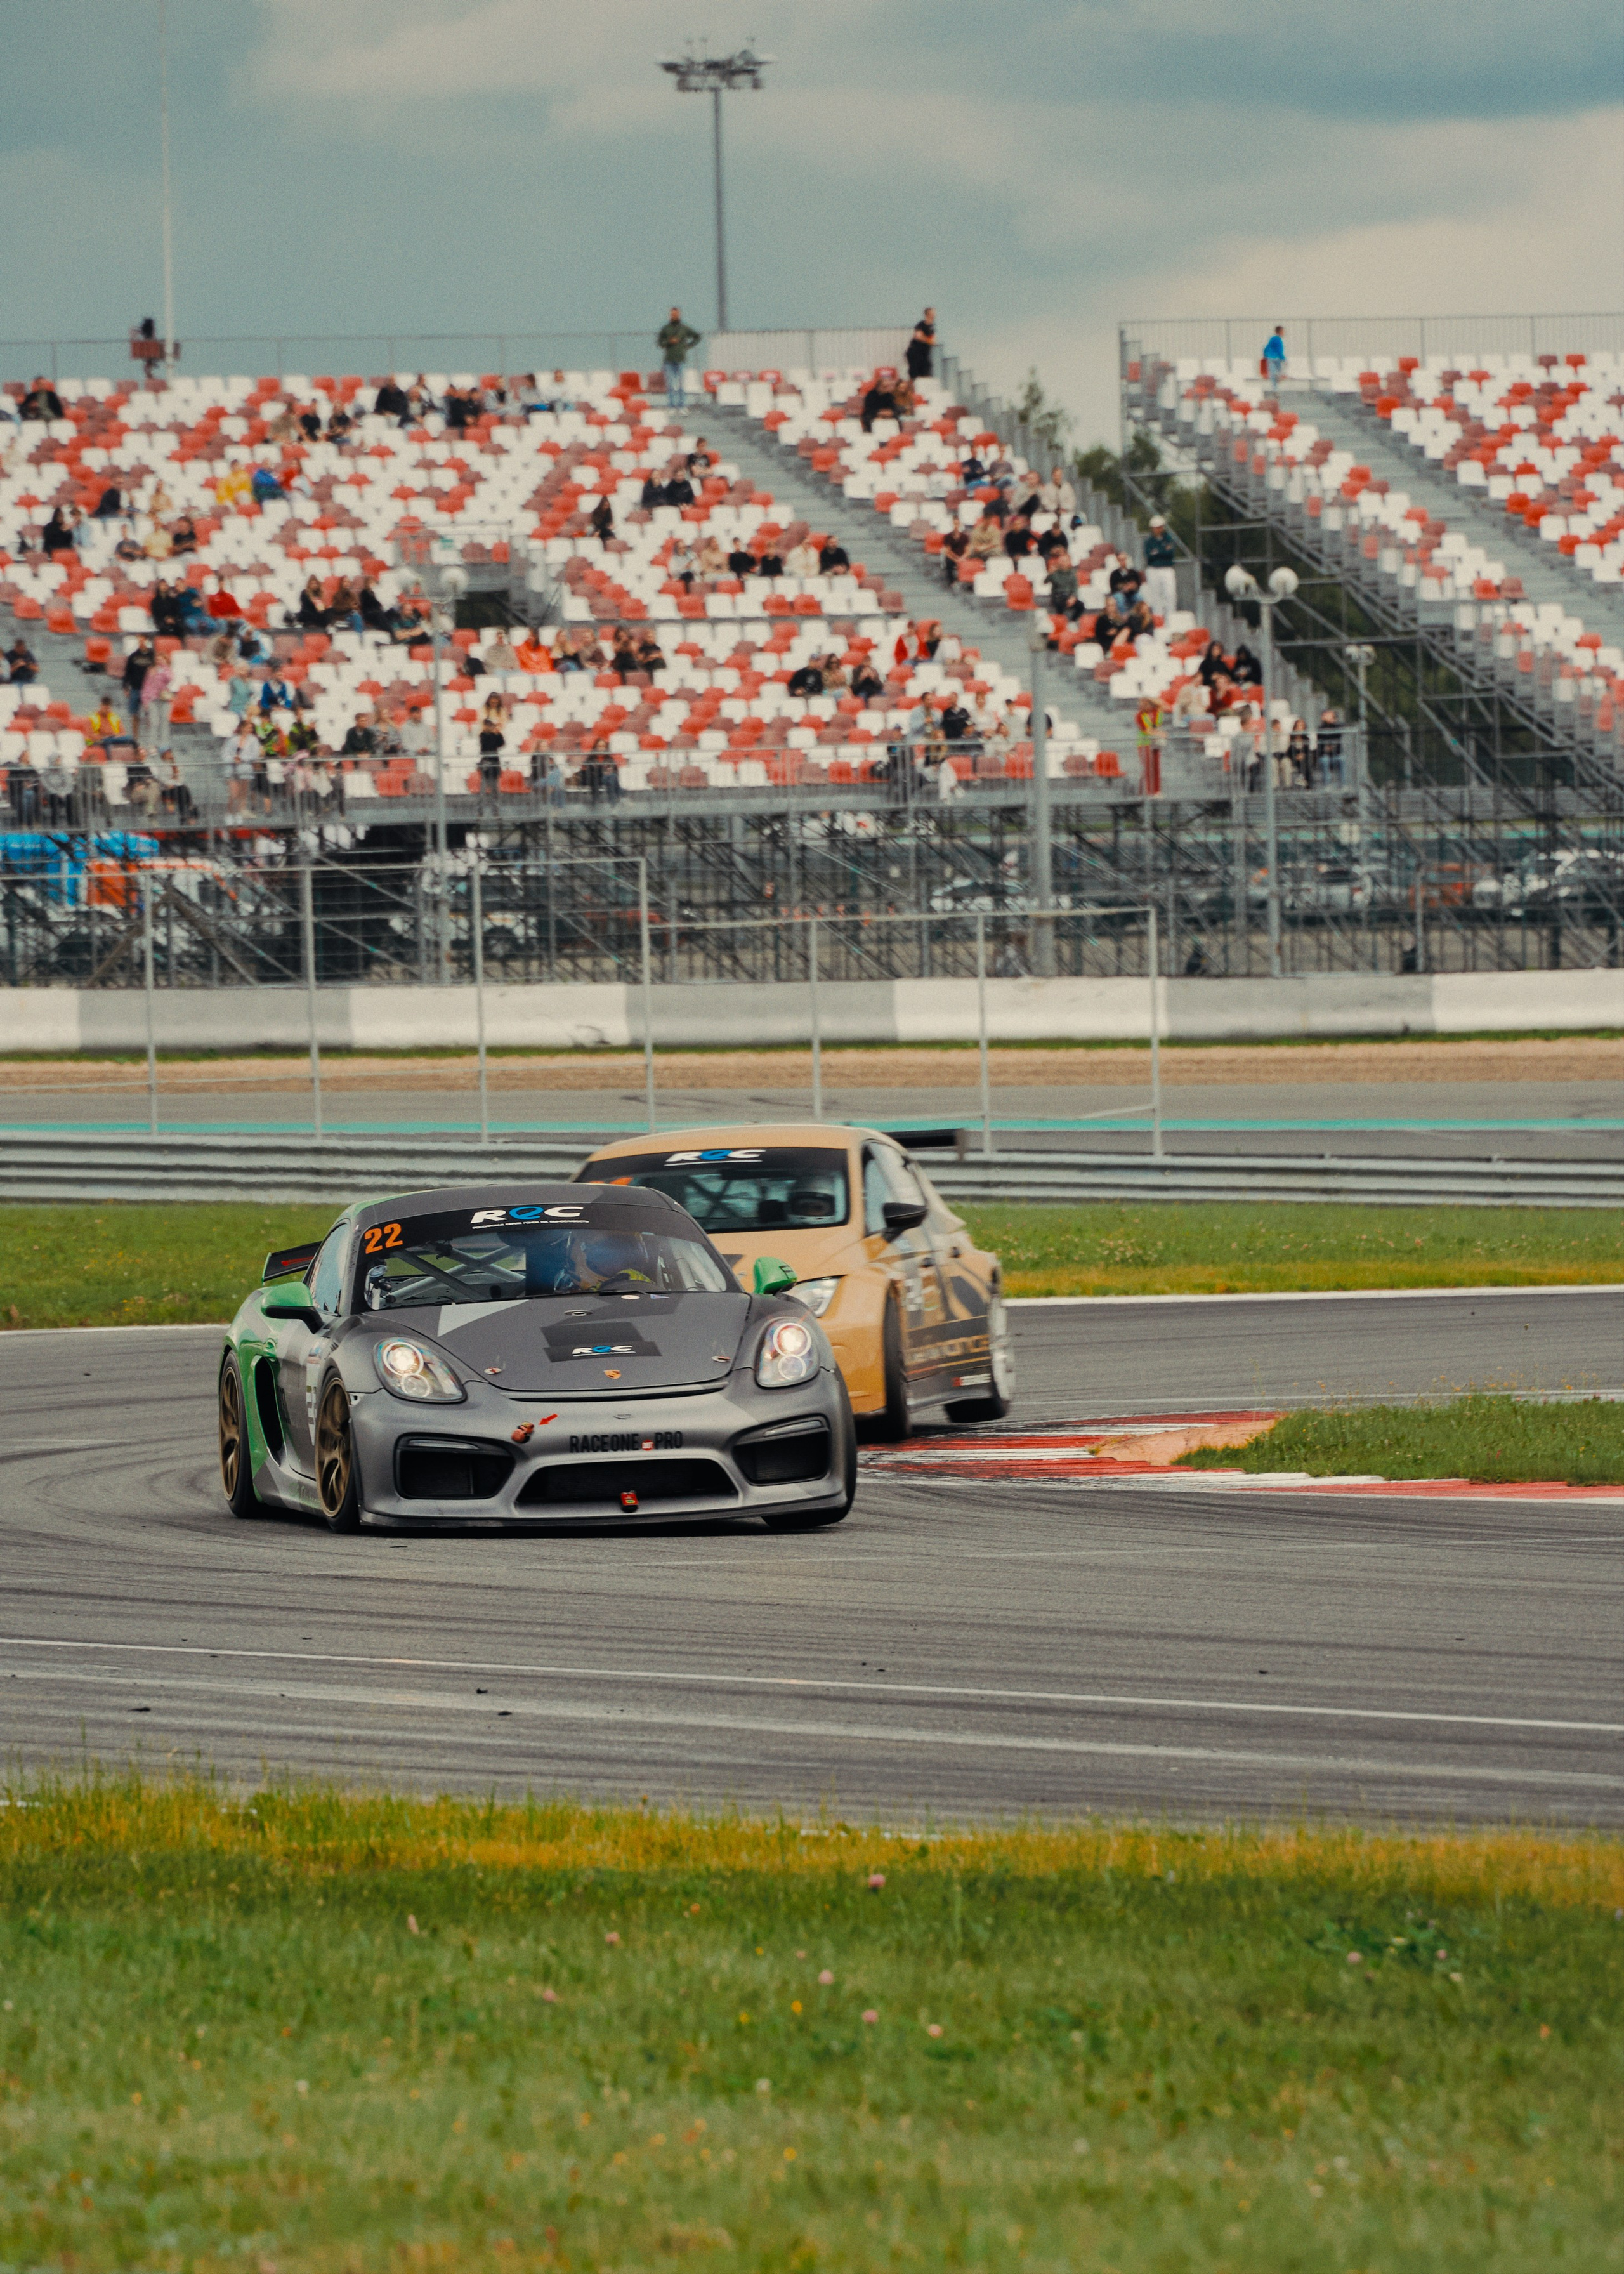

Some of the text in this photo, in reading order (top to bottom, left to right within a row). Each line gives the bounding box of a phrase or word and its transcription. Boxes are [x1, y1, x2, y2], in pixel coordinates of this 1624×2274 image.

[364, 1223, 403, 1254] 22
[570, 1433, 639, 1453] RACEONE
[654, 1431, 683, 1449] PRO
